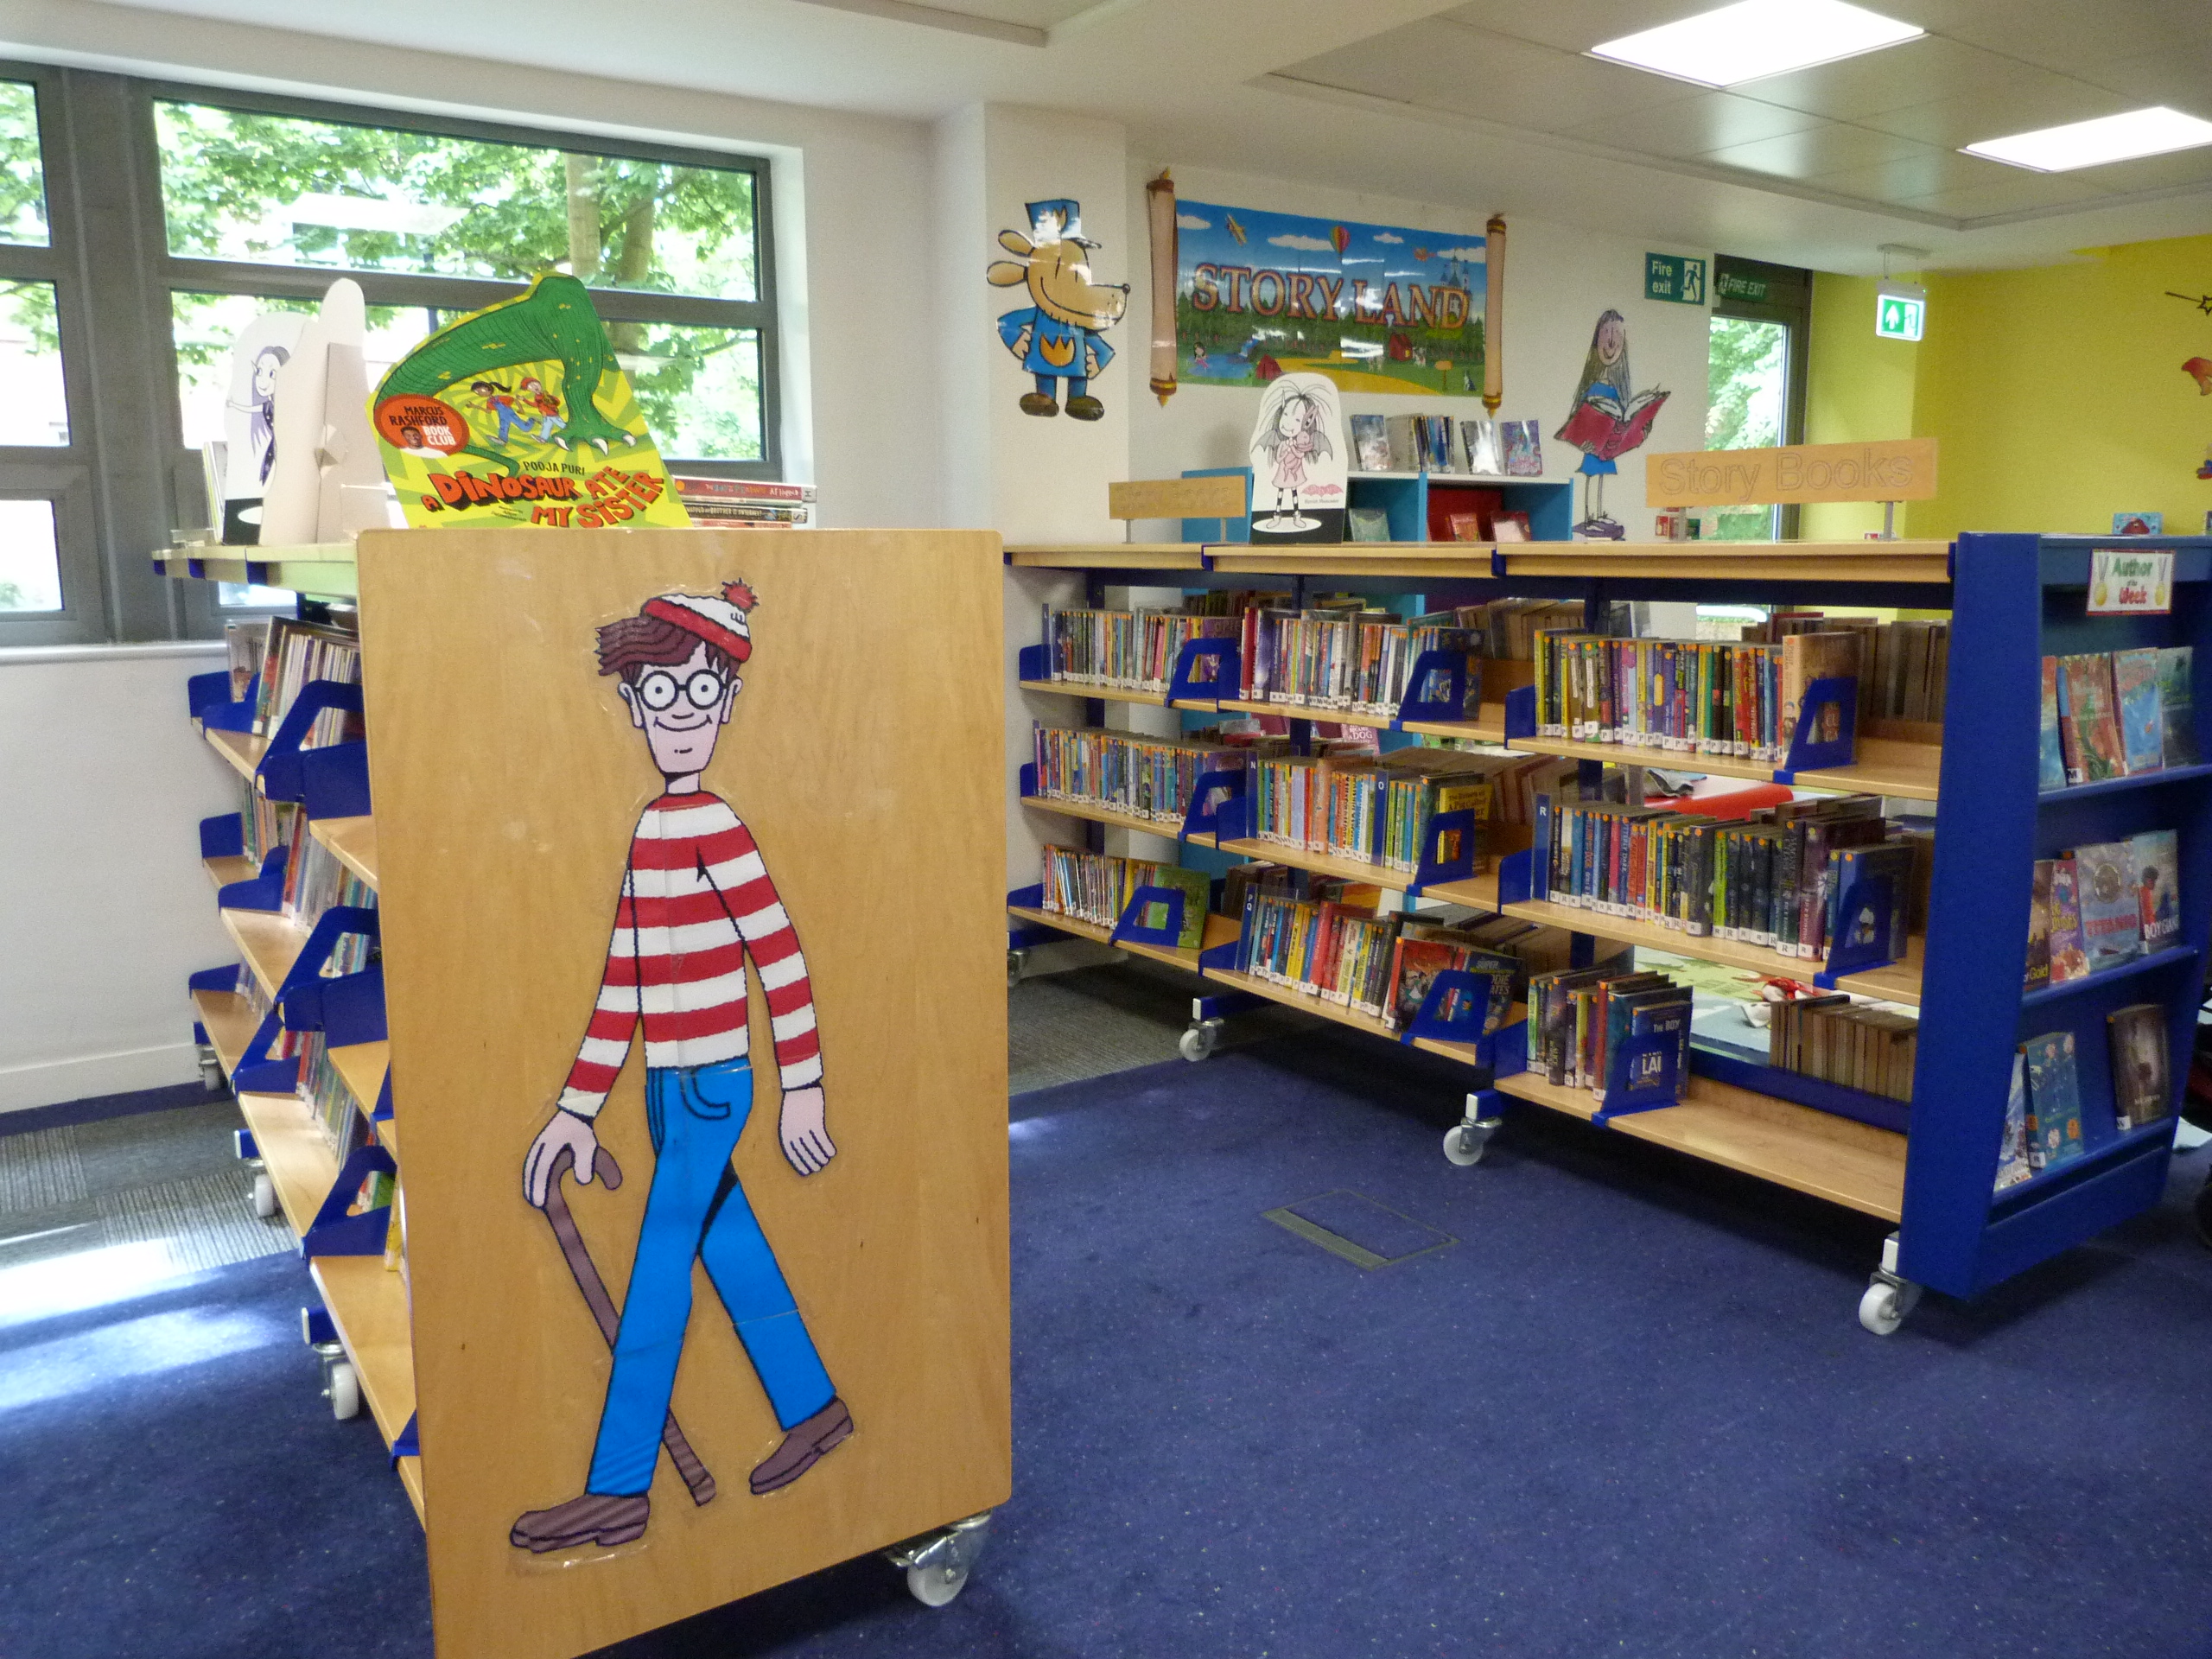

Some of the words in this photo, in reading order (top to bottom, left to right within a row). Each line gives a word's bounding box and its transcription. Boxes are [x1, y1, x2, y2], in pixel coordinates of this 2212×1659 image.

[1651, 259, 1673, 277] Fire
[1651, 279, 1672, 295] exit
[1728, 277, 1747, 294] FIRE
[1748, 281, 1767, 298] EXIT
[1192, 262, 1344, 322] STORY
[1352, 279, 1471, 330] LAND
[404, 405, 445, 416] MARCUS
[389, 414, 448, 427] RASHFORD
[422, 425, 452, 437] BOOK
[427, 433, 456, 447] CLUB
[523, 461, 560, 474] POOJA
[562, 464, 585, 476] PURI
[1659, 457, 1761, 502] Story
[1775, 448, 1914, 491] Books
[421, 494, 440, 512] A
[584, 466, 632, 500] ATE
[531, 505, 574, 528] MY
[2112, 556, 2153, 577] Author
[2119, 584, 2147, 604] Week
[1353, 731, 1373, 740] DOG
[1540, 806, 1547, 816] R
[1247, 902, 1252, 911] Q
